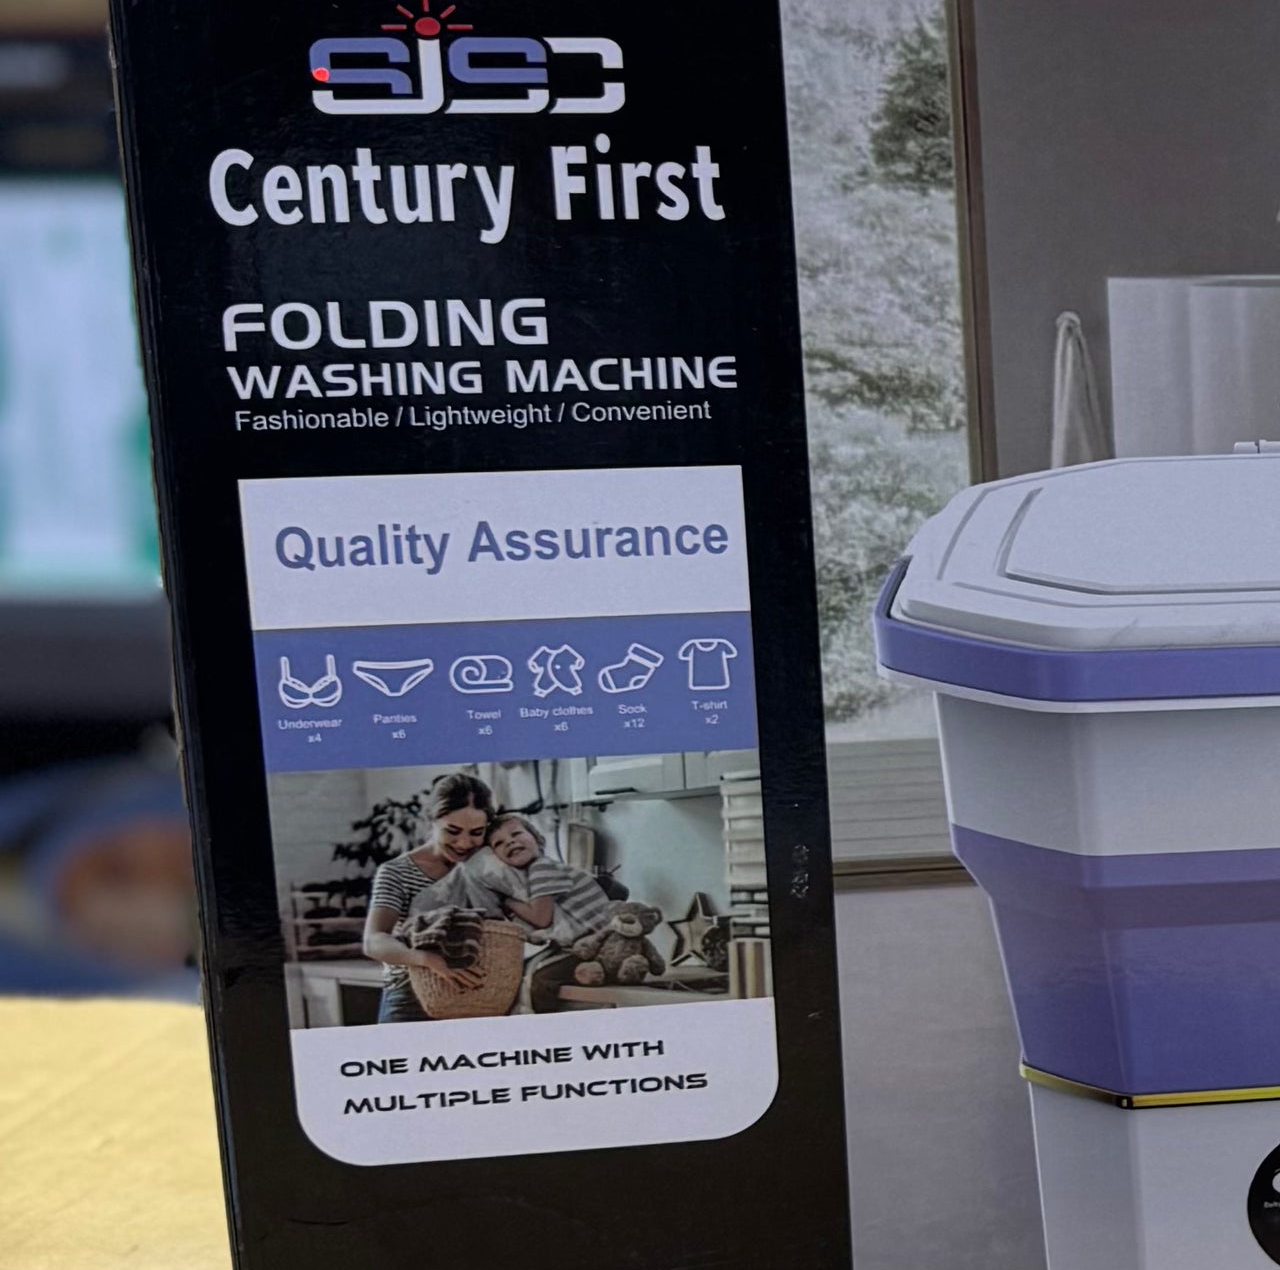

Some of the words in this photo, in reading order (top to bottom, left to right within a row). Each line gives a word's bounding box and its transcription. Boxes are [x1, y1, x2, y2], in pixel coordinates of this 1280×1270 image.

[208, 147, 515, 245] Century
[550, 132, 726, 221] First
[221, 298, 550, 352] FOLDING
[226, 360, 483, 400] WASHING
[506, 355, 738, 393] MACHINE
[235, 405, 389, 431] Fashionable
[410, 403, 552, 431] Lightweight
[571, 400, 712, 423] Convenient
[275, 523, 451, 575] Quality
[467, 520, 729, 563] Assurance
[618, 704, 648, 715] Sock
[691, 700, 728, 711] T-shirt
[466, 709, 501, 720] Towel
[520, 707, 549, 719] Baby
[552, 705, 593, 717] clothes
[277, 718, 342, 730] Underwear
[373, 714, 417, 725] Panties
[624, 718, 645, 729] x12
[705, 715, 719, 725] x2
[478, 725, 493, 736] x6
[554, 721, 569, 731] x6
[307, 732, 322, 743] x4
[391, 729, 407, 739] x6
[339, 1057, 409, 1078] ONE
[418, 1046, 573, 1073] MACHINE
[581, 1039, 665, 1061] WITH
[343, 1086, 511, 1115] MULTIPLE
[521, 1073, 709, 1102] FUNCTIONS
